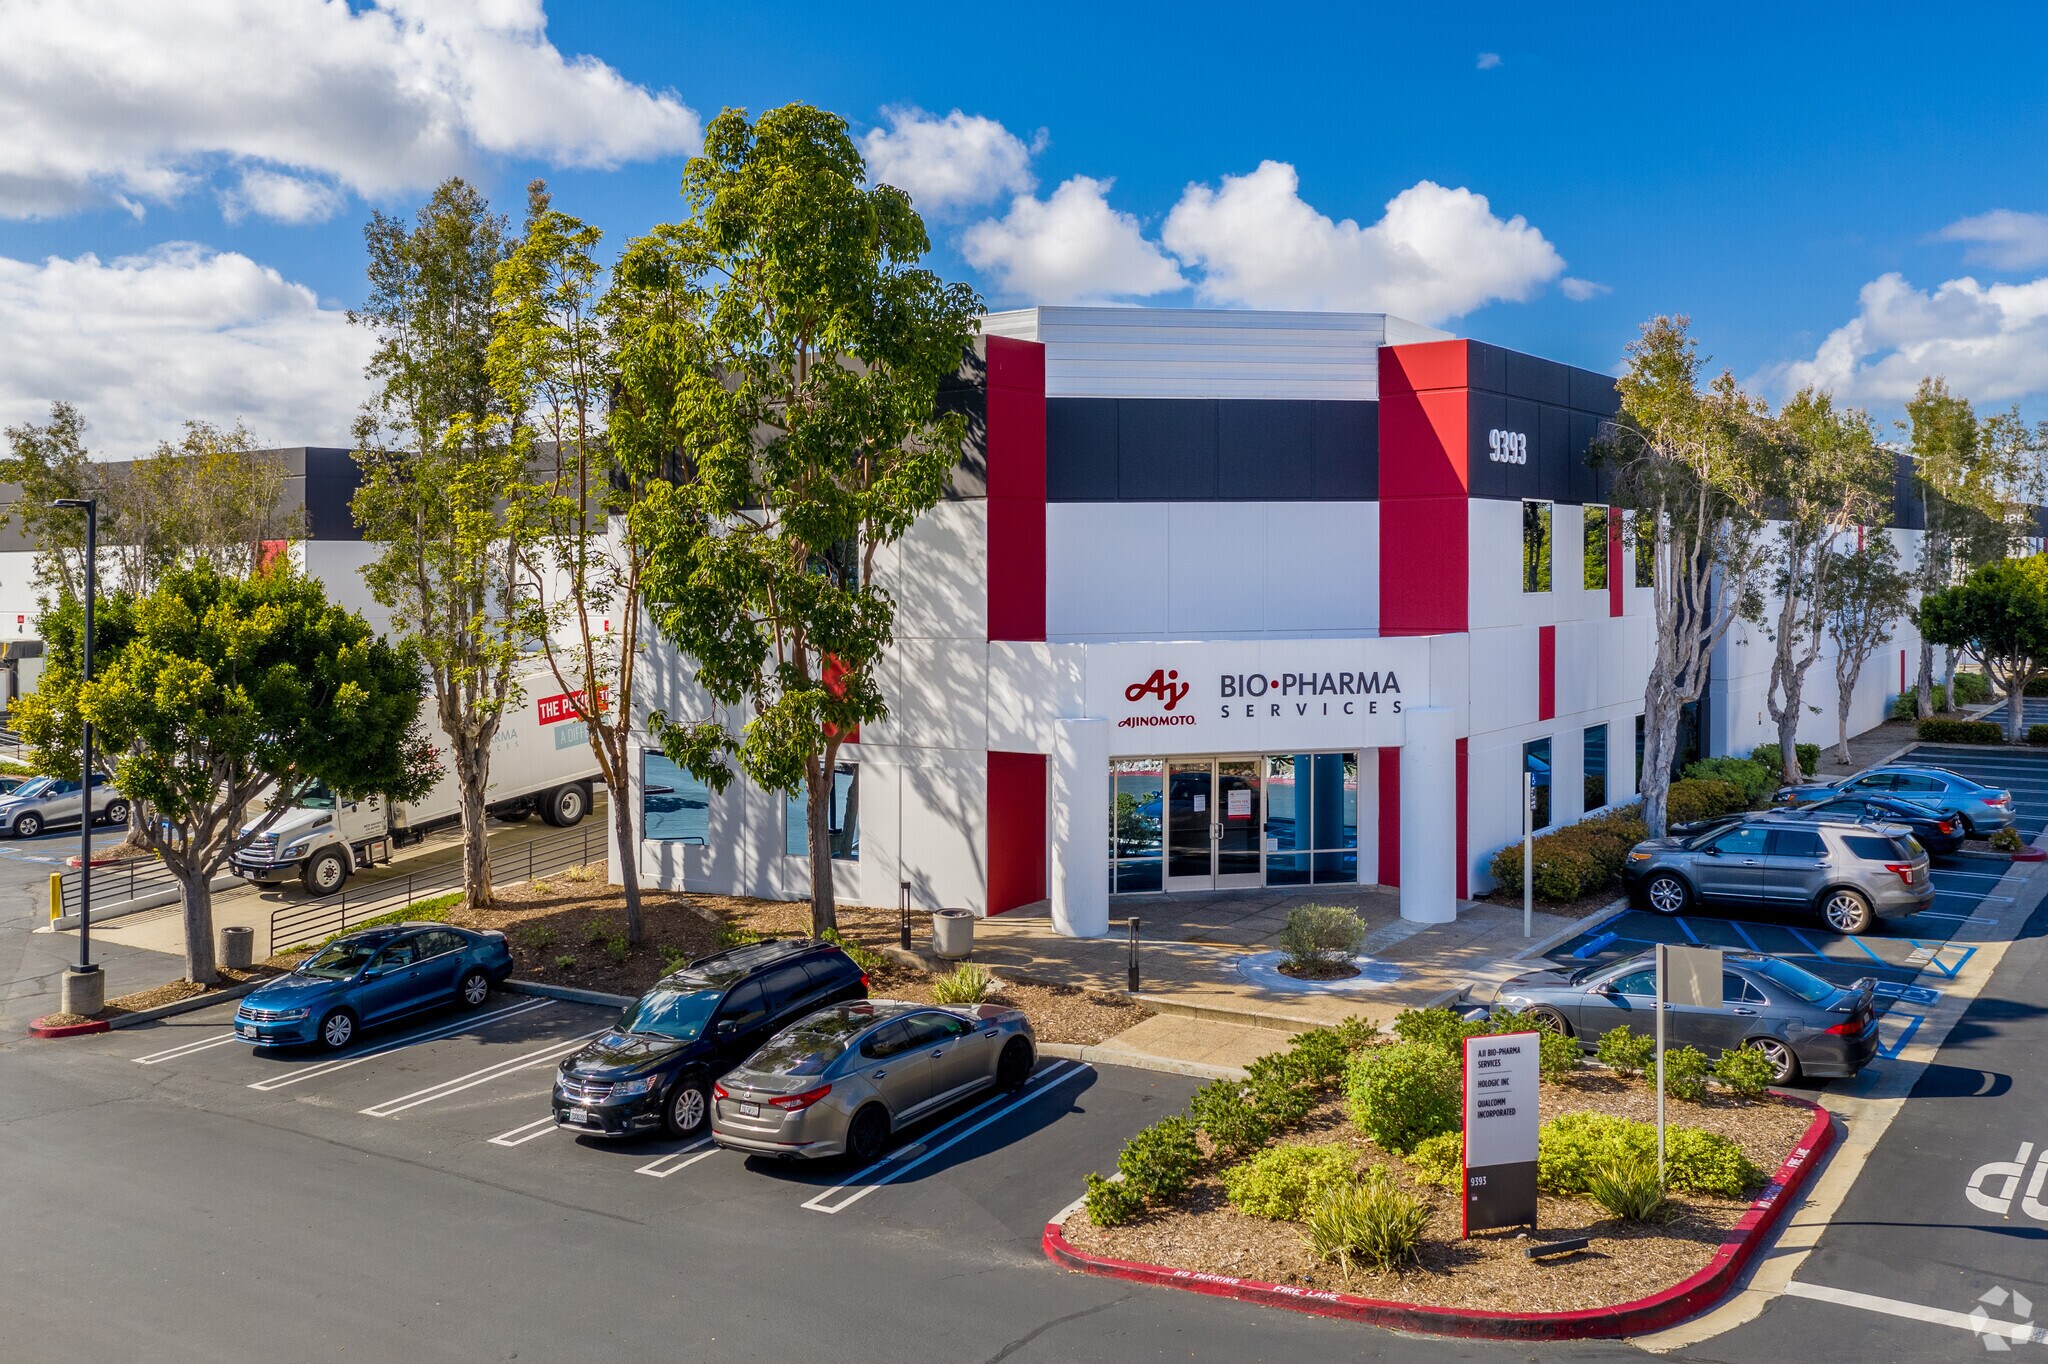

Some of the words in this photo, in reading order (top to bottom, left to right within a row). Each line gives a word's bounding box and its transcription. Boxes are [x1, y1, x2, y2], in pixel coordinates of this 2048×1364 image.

[1488, 428, 1527, 465] 9393
[539, 700, 560, 719] THE
[1220, 700, 1402, 718] SERVICES
[1118, 715, 1195, 728] AJINOMOTO
[560, 730, 567, 745] A
[1487, 1046, 1520, 1056] BIO-PHARMA
[1478, 1059, 1501, 1068] SERVICES
[1478, 1079, 1499, 1088] HOLOGIC
[1501, 1078, 1509, 1086] INC
[1478, 1098, 1505, 1107] QUALCOMM
[1478, 1108, 1515, 1118] INCORPORATED
[1470, 1175, 1487, 1186] 9393
[1193, 1272, 1240, 1285] PARKING
[1273, 1285, 1303, 1296] FIRE
[1306, 1291, 1340, 1301] LANE
